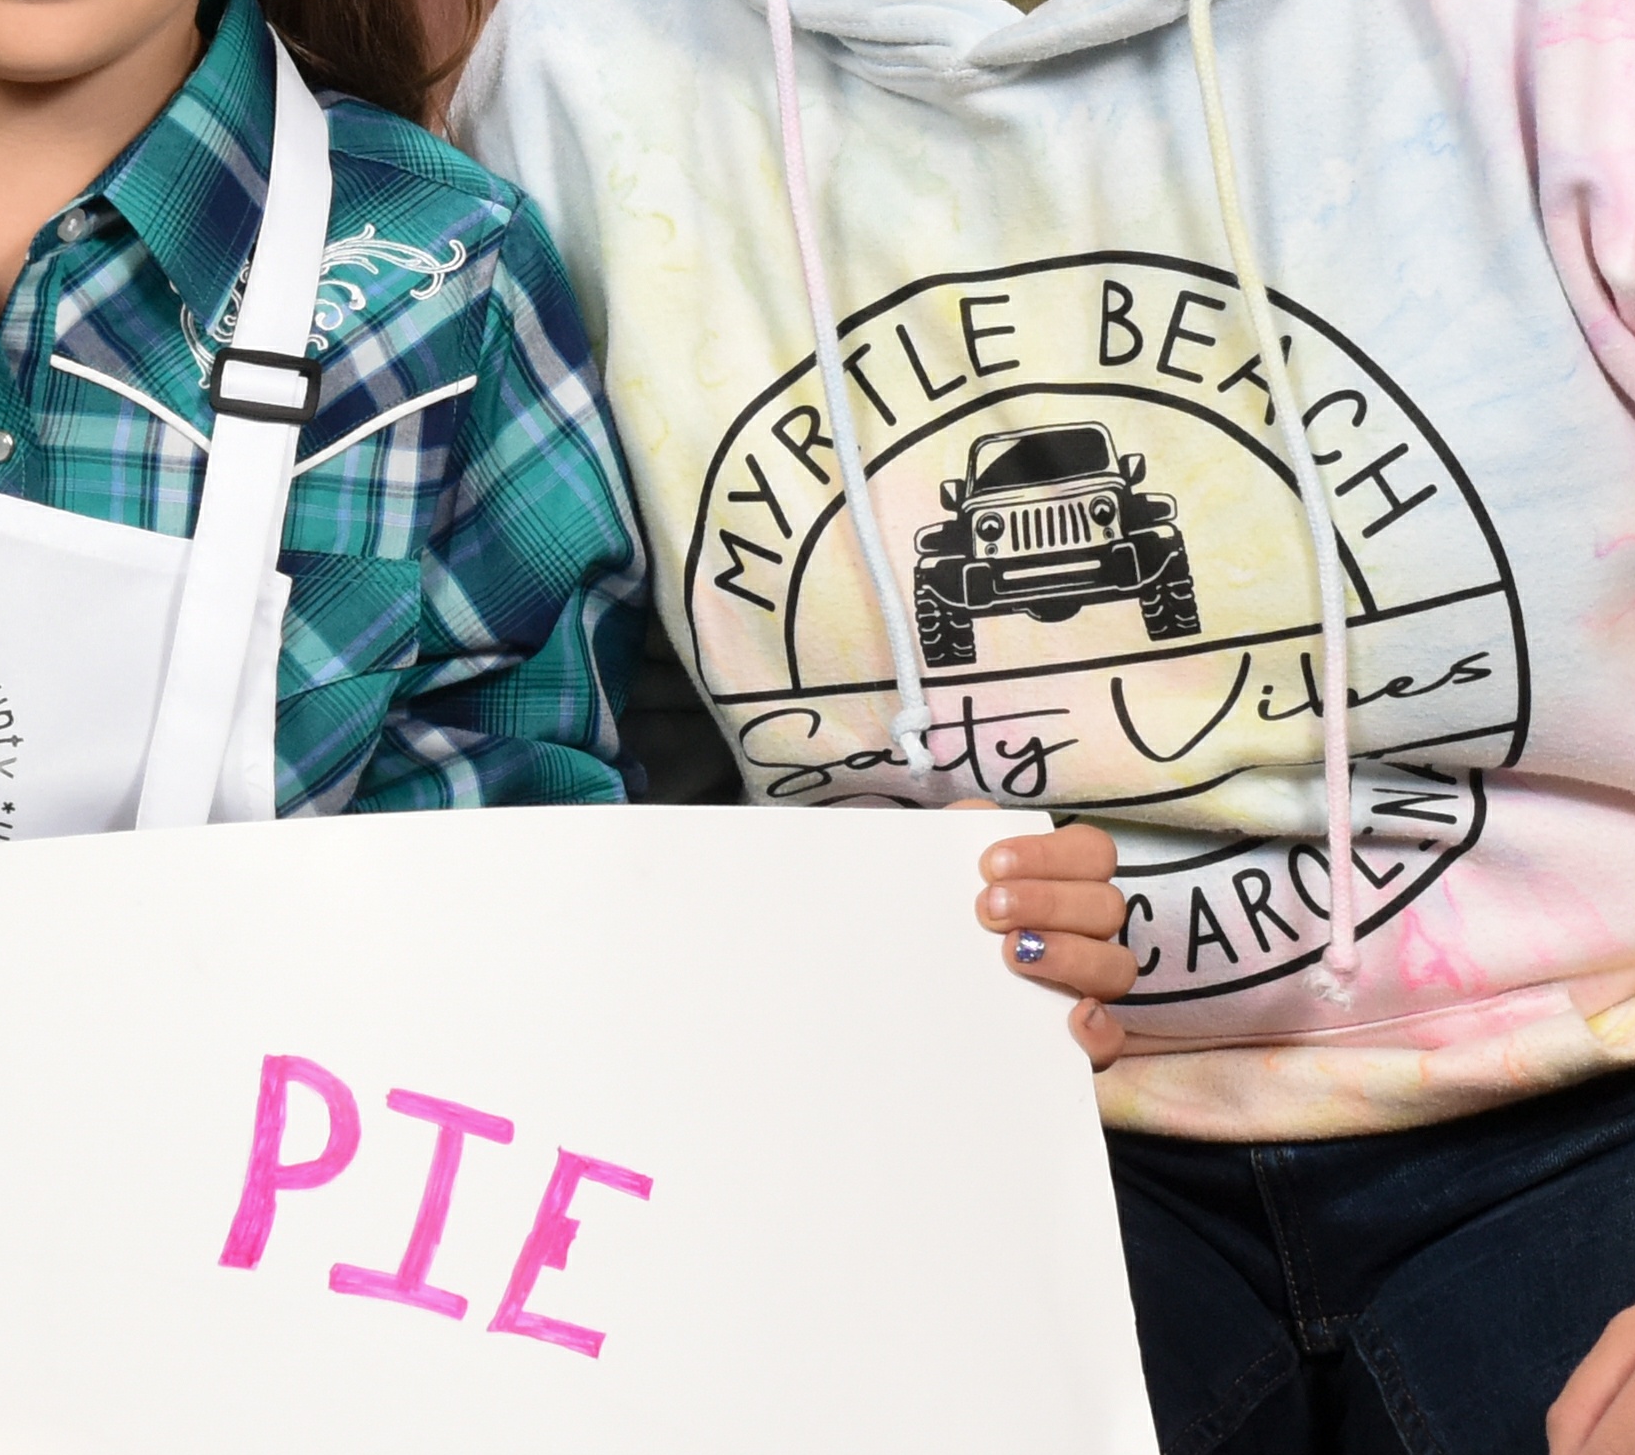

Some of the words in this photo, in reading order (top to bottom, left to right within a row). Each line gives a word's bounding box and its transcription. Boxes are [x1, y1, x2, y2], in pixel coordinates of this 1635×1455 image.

[714, 294, 1020, 612] MYRTLE
[1099, 279, 1437, 539] BEACH
[217, 1054, 654, 1359] PIE
